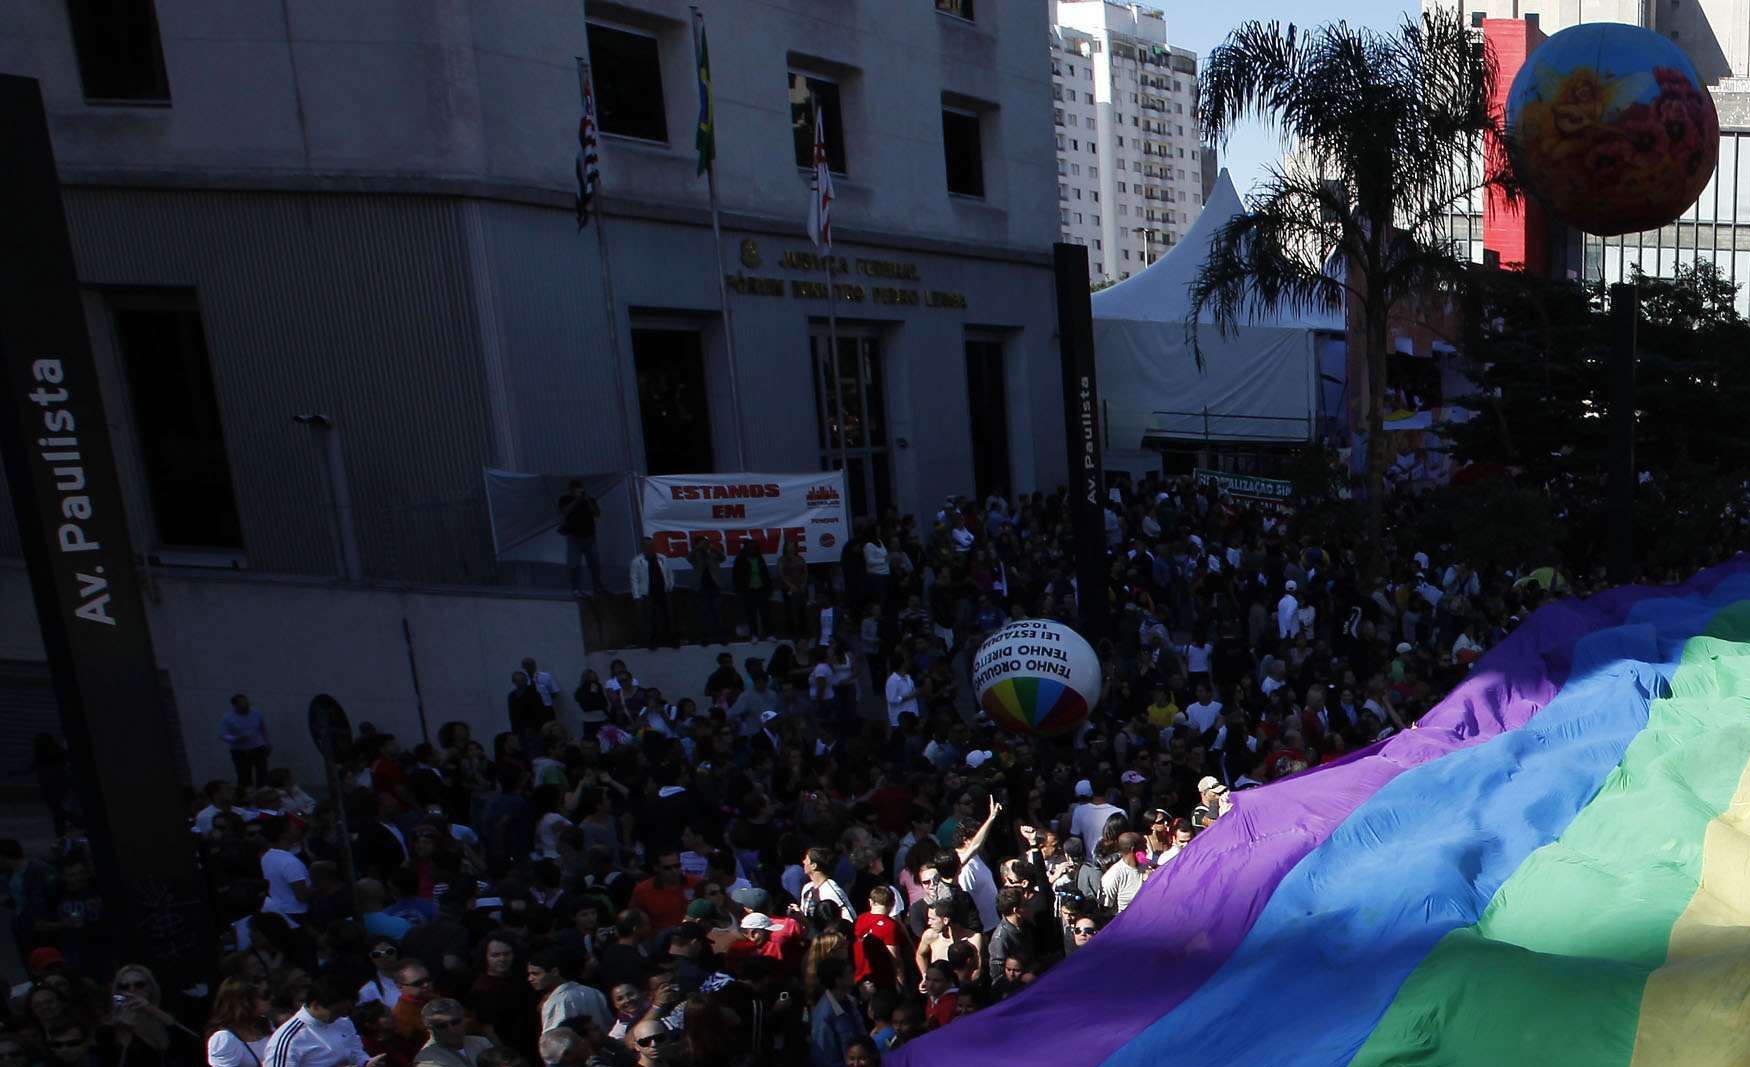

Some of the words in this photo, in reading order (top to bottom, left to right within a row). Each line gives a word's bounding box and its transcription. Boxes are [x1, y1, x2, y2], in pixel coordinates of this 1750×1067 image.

[1080, 375, 1096, 469] Paulista
[28, 358, 101, 553] Paulista
[671, 484, 780, 500] ESTAMOS
[1087, 474, 1098, 505] Av.
[712, 504, 745, 519] EM
[75, 565, 118, 626] Av.
[1040, 631, 1060, 641] LEI
[1018, 645, 1067, 662] TENHO
[1026, 659, 1071, 679] TENHO
